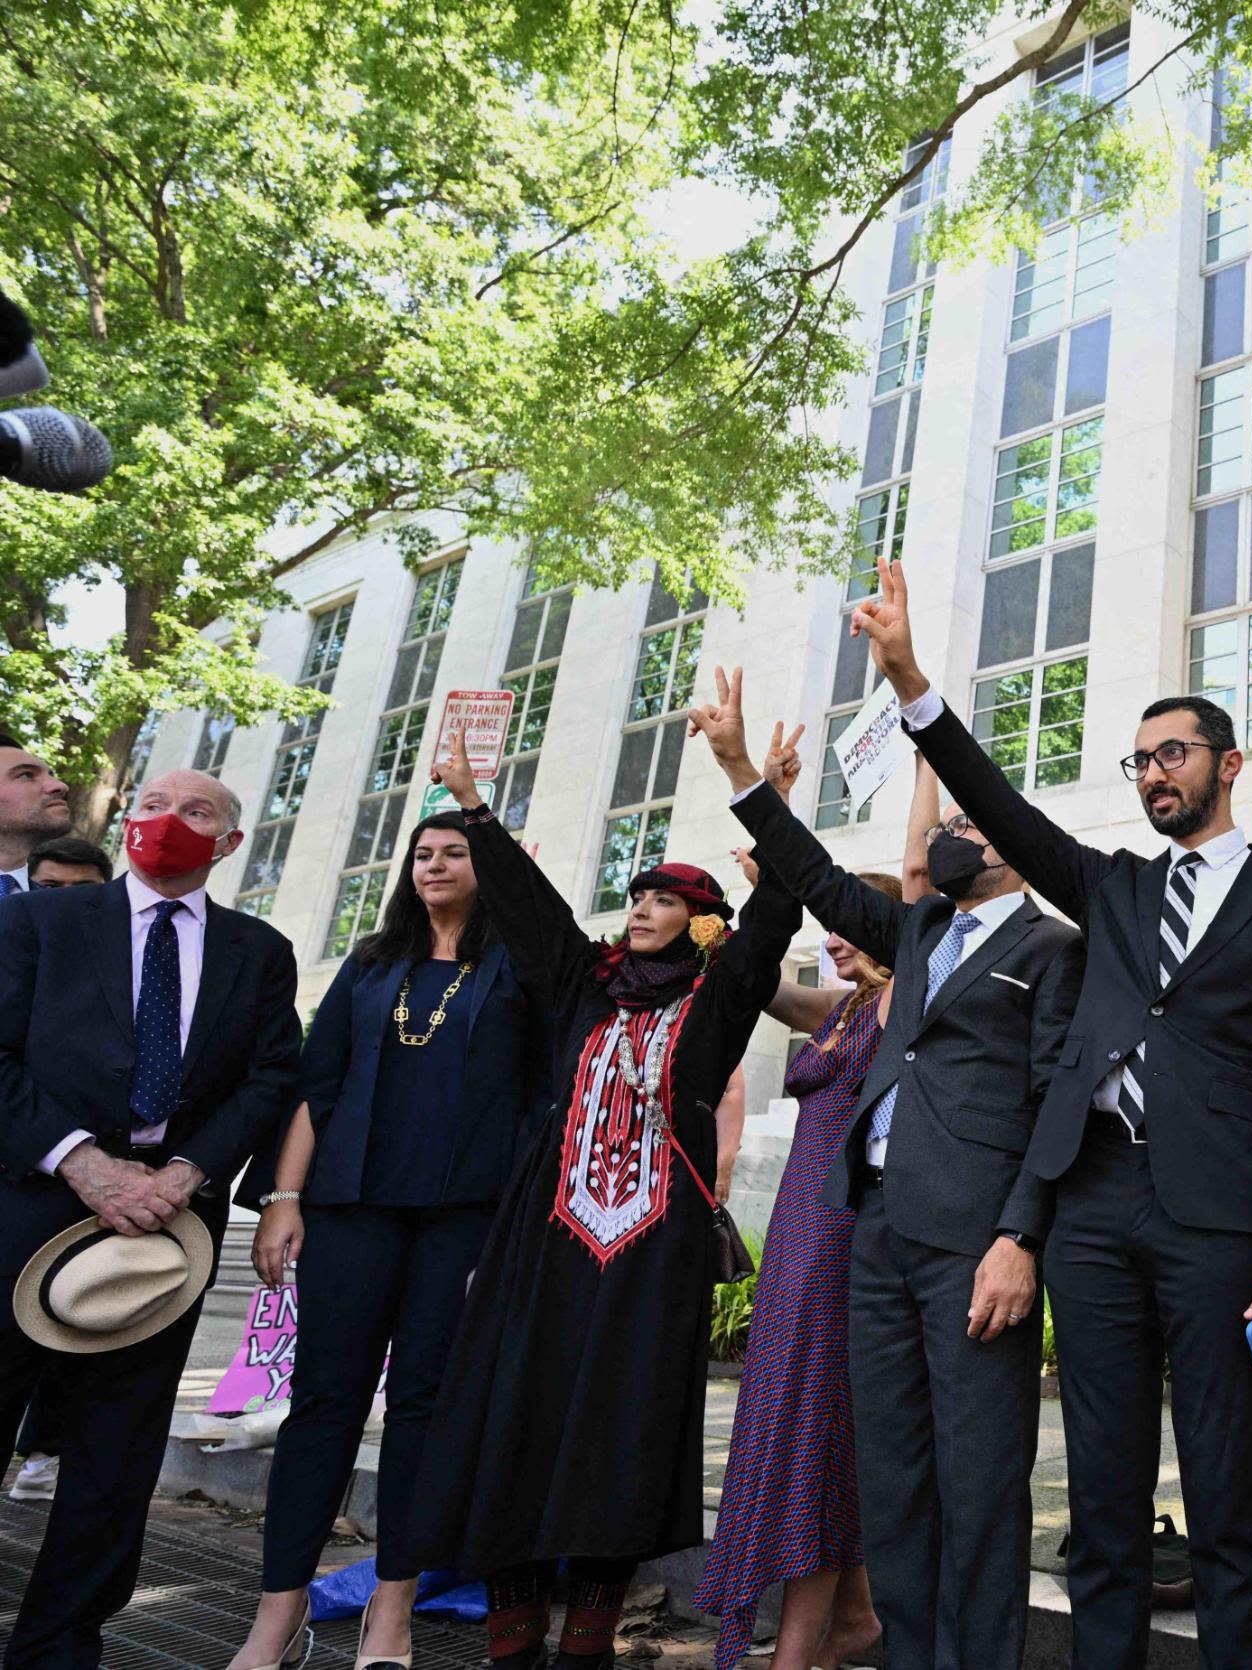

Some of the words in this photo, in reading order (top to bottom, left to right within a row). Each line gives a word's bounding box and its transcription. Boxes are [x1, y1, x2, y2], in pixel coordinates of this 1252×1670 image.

[447, 703, 461, 714] NO
[465, 704, 508, 716] PARKING
[449, 717, 500, 729] ENTRANCE
[844, 696, 897, 764] DEMOCRACY
